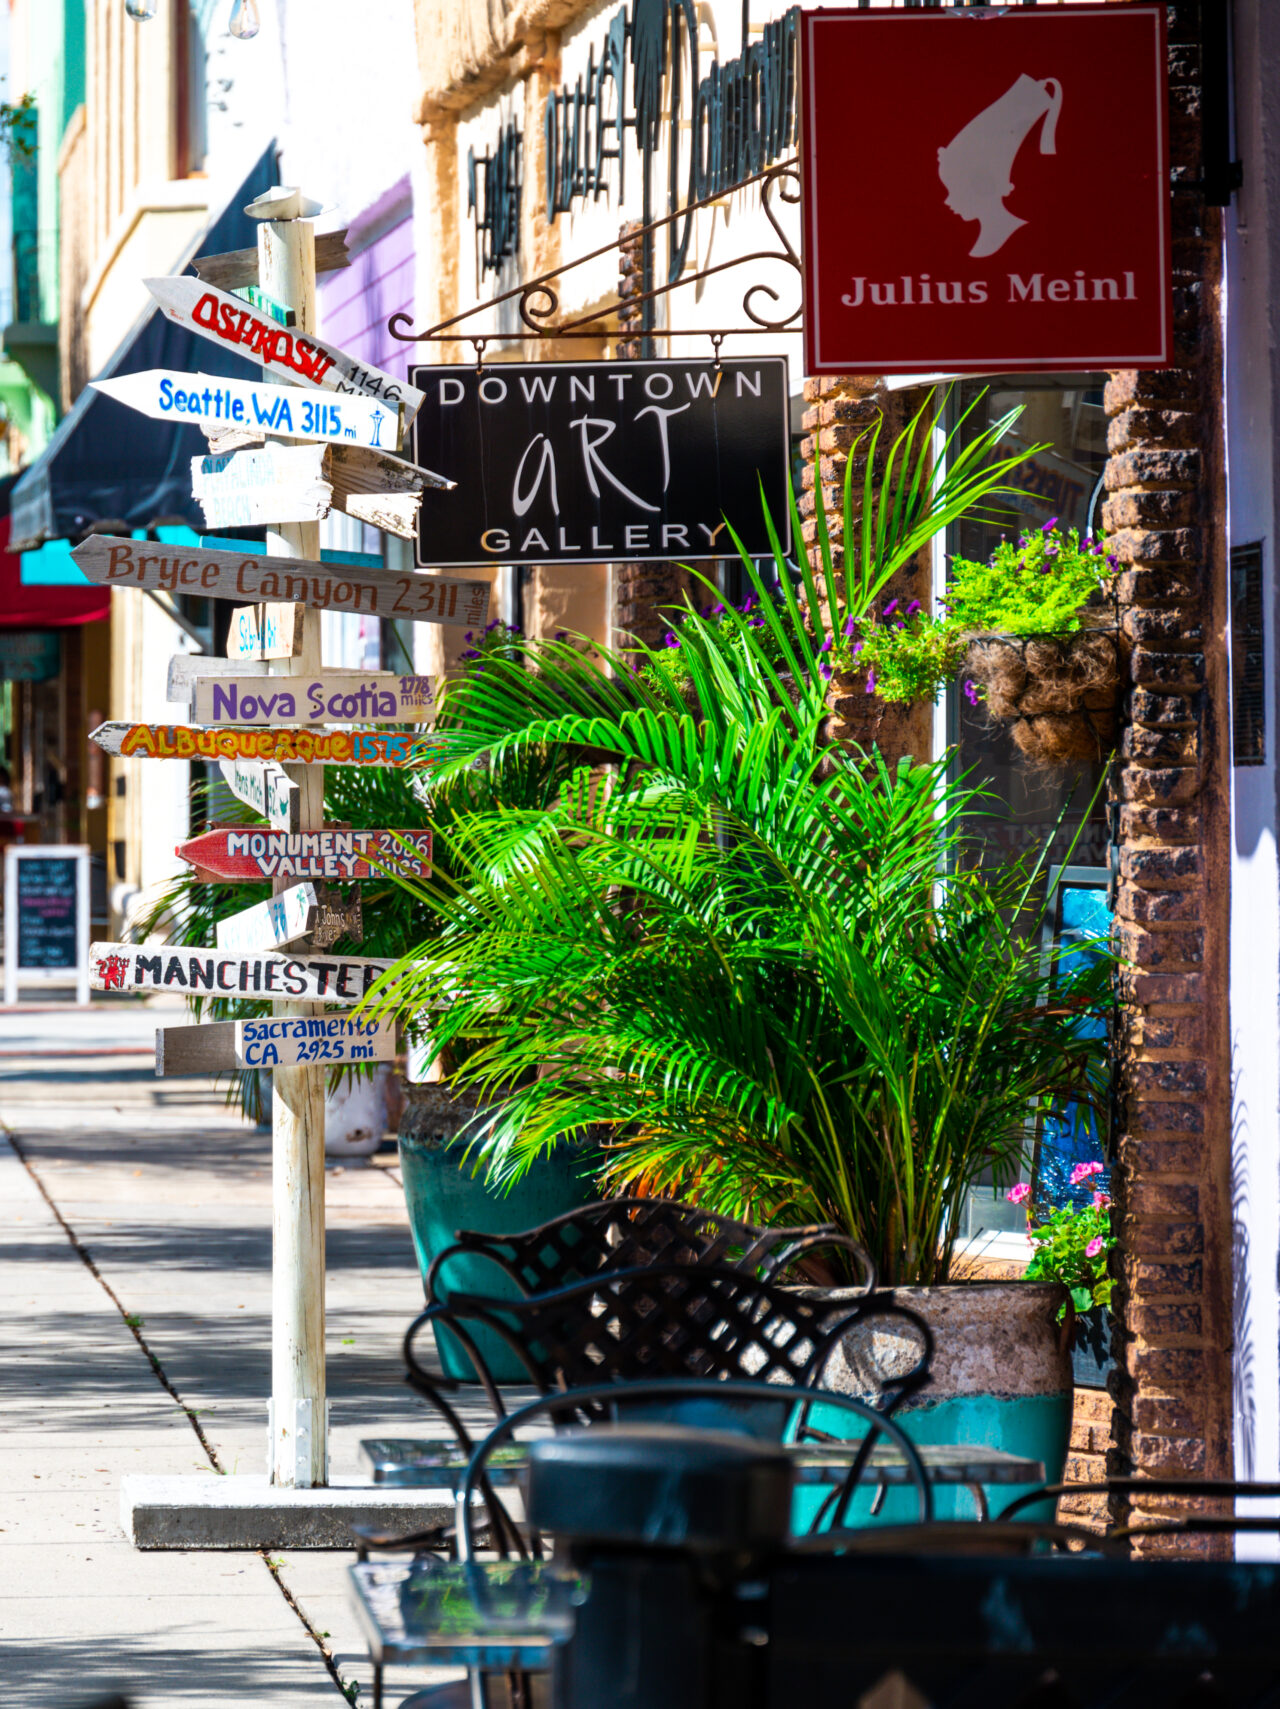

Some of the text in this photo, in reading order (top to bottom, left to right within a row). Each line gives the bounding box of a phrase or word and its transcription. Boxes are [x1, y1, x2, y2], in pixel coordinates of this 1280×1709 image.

[841, 270, 1138, 307] Julius Meinl
[191, 292, 402, 401] OSHKOSH 1146
[438, 370, 763, 406] DOWNTOWN
[158, 378, 251, 426] Seattle,
[251, 392, 294, 432] WA
[344, 425, 357, 439] mi
[480, 522, 726, 553] GALLERY
[105, 544, 458, 617] Bryce Canyon 2,311
[464, 586, 486, 626] miles
[212, 681, 397, 721] Nova Scotia
[399, 675, 431, 695] 1778
[227, 831, 374, 858] MONUMENT
[256, 853, 360, 878] VALLEY
[135, 954, 389, 999] MANCHESTER
[243, 1016, 380, 1042] Sacramento
[296, 1040, 345, 1062] 2925
